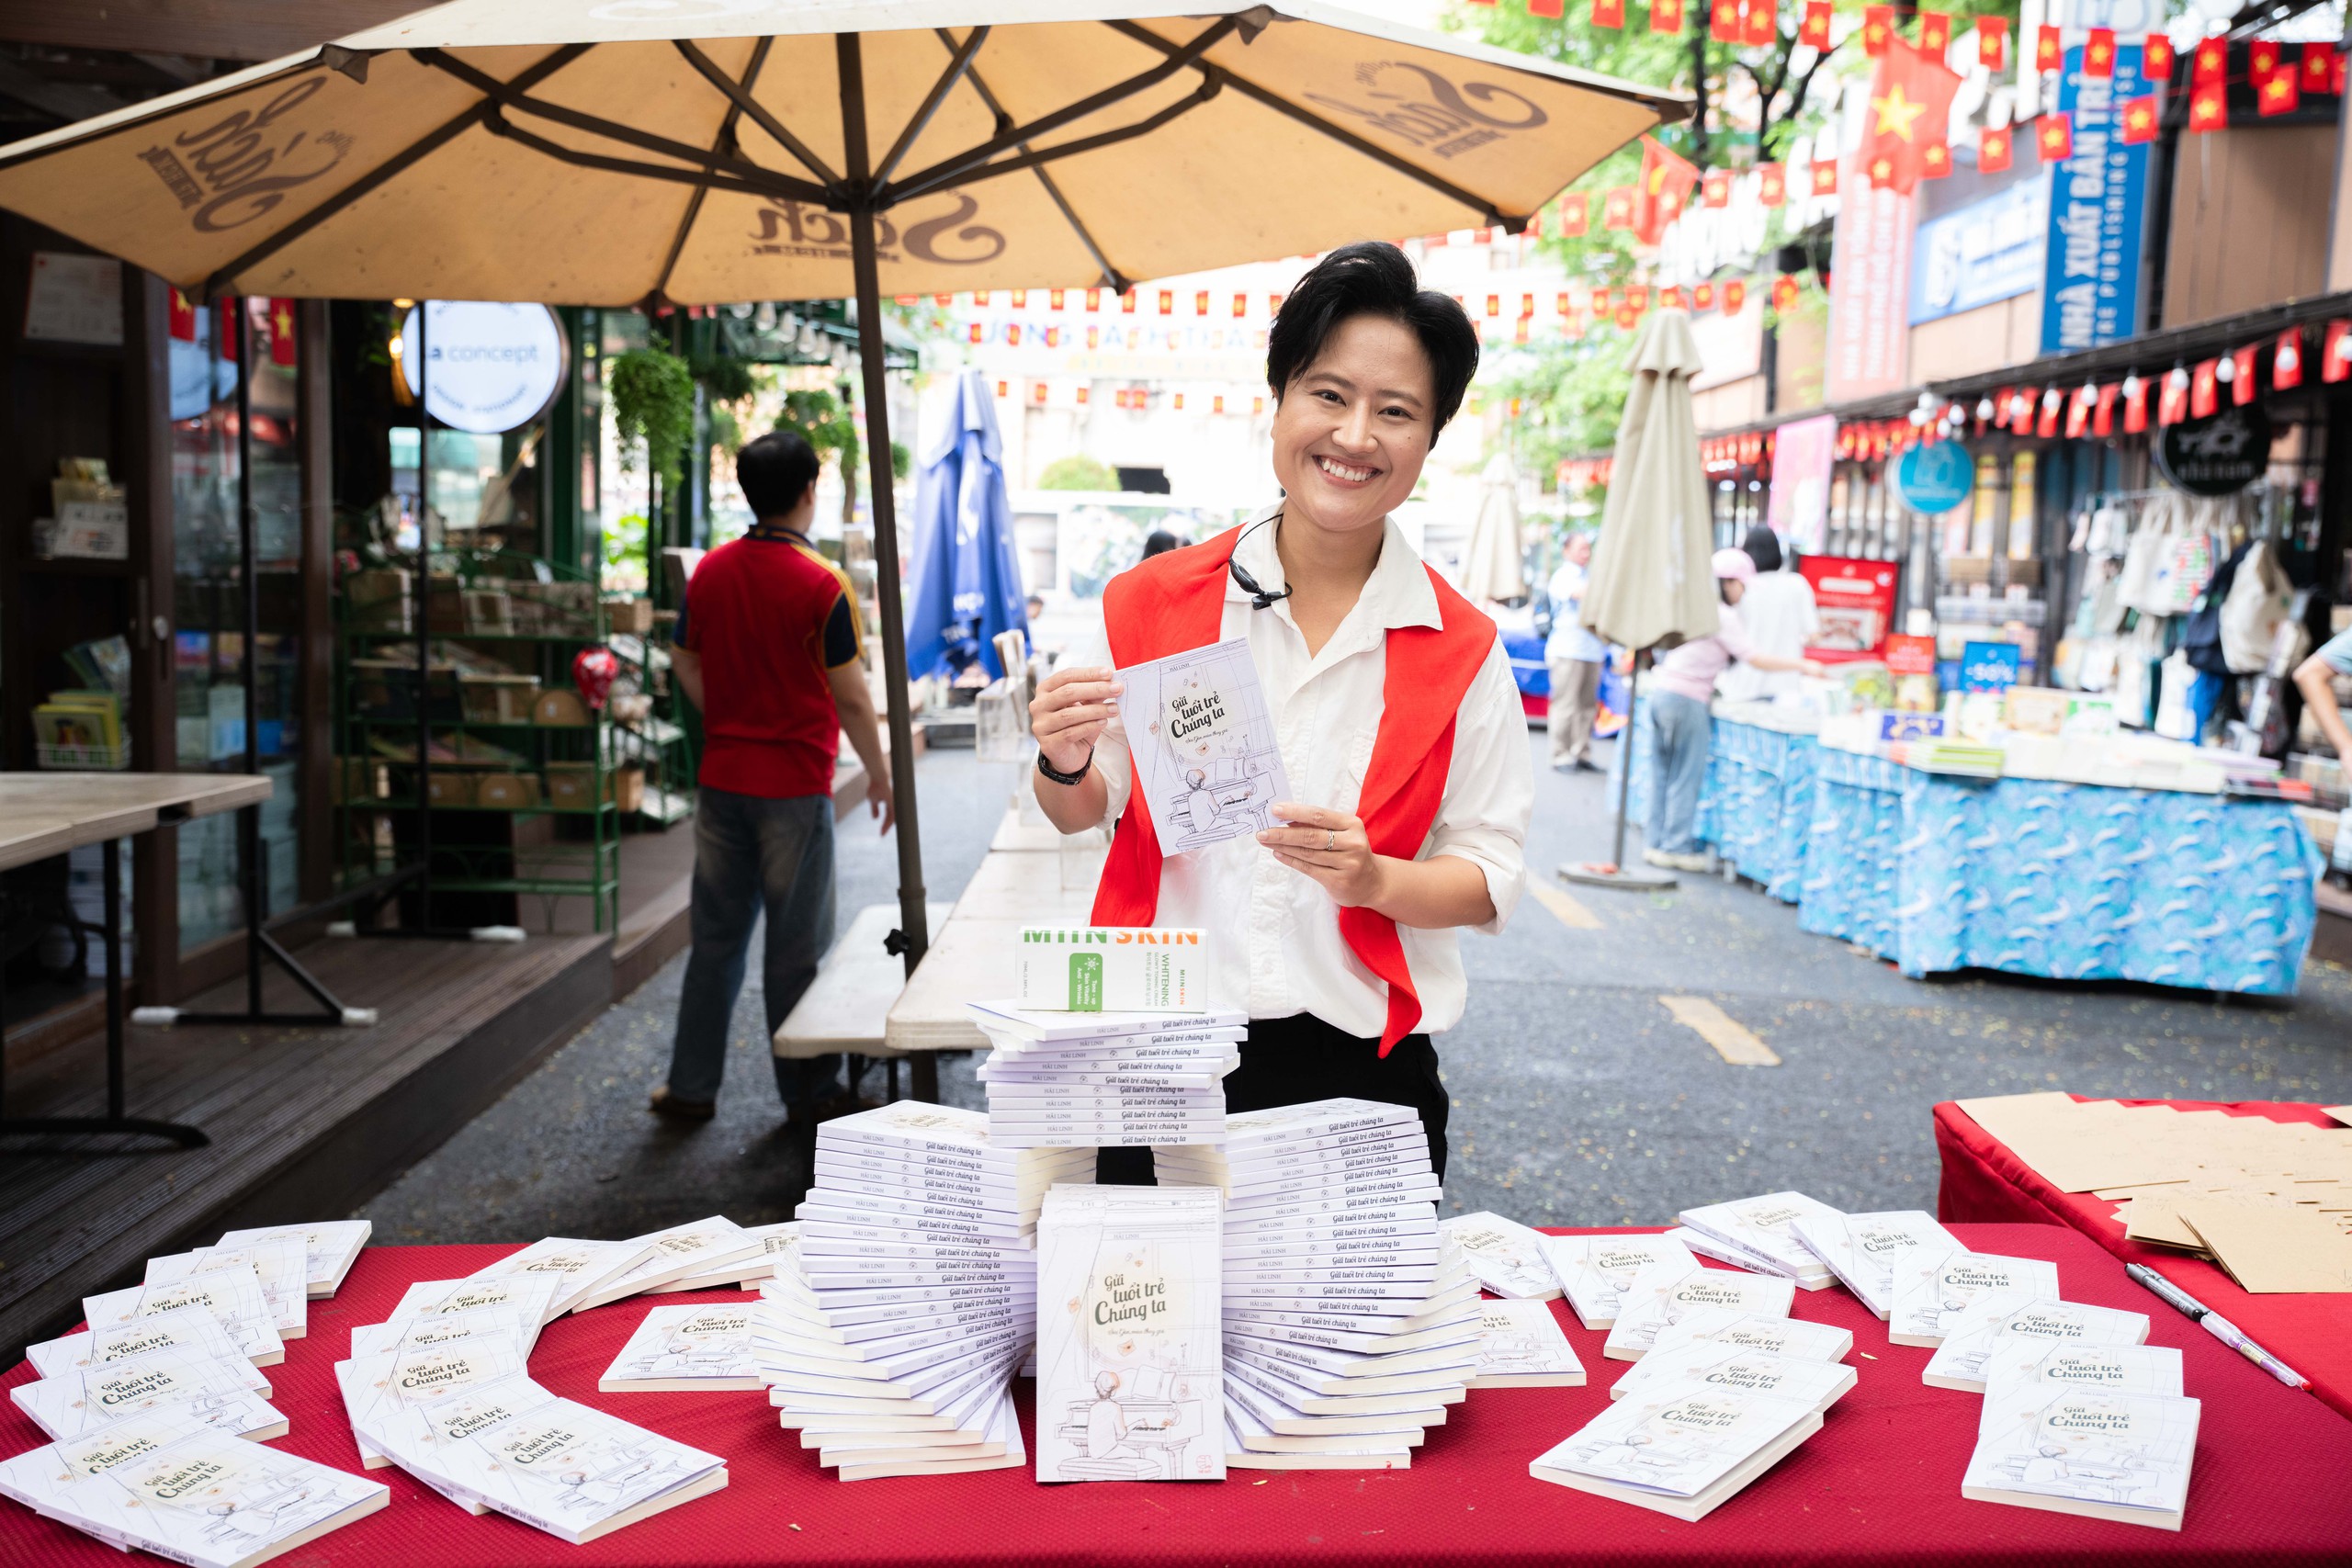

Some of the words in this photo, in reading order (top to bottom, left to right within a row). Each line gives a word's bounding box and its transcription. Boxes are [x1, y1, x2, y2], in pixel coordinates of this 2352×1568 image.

[447, 344, 538, 367] concept
[1172, 696, 1188, 712] Gửi
[1182, 700, 1204, 719] tuổi
[1204, 691, 1221, 708] trẻ
[1171, 714, 1212, 739] Chúng
[1213, 707, 1225, 719] ta
[1104, 1274, 1124, 1292] Gửi
[1114, 1282, 1141, 1303] tuổi
[1145, 1277, 1166, 1297] trẻ
[1095, 1301, 1147, 1325] Chúng
[1152, 1300, 1166, 1314] ta
